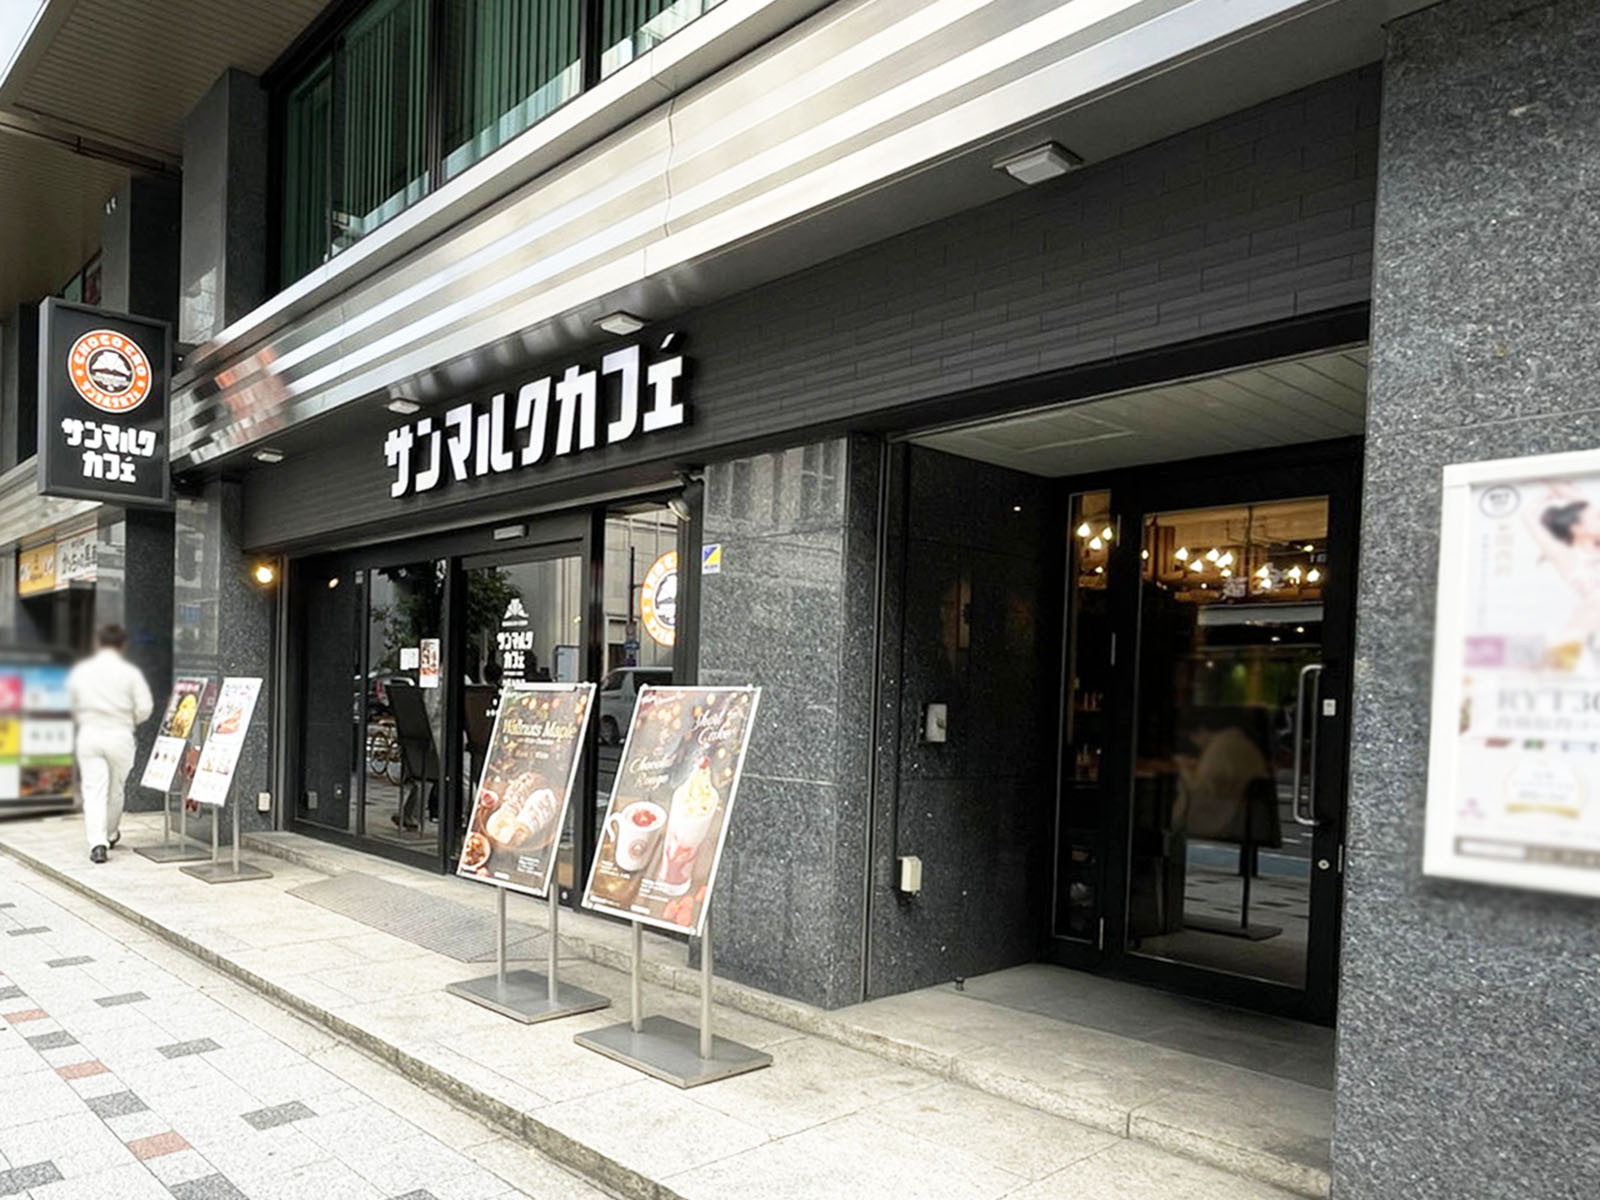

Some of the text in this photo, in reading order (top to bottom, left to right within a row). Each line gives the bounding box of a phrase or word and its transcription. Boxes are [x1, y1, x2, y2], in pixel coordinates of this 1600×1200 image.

[74, 333, 123, 364] CHOCO
[384, 333, 684, 498] サンマルクカフェ
[61, 418, 156, 457] サンマルク
[82, 450, 137, 483] カフェ
[496, 631, 534, 650] サンマルク
[503, 651, 526, 669] カフェ
